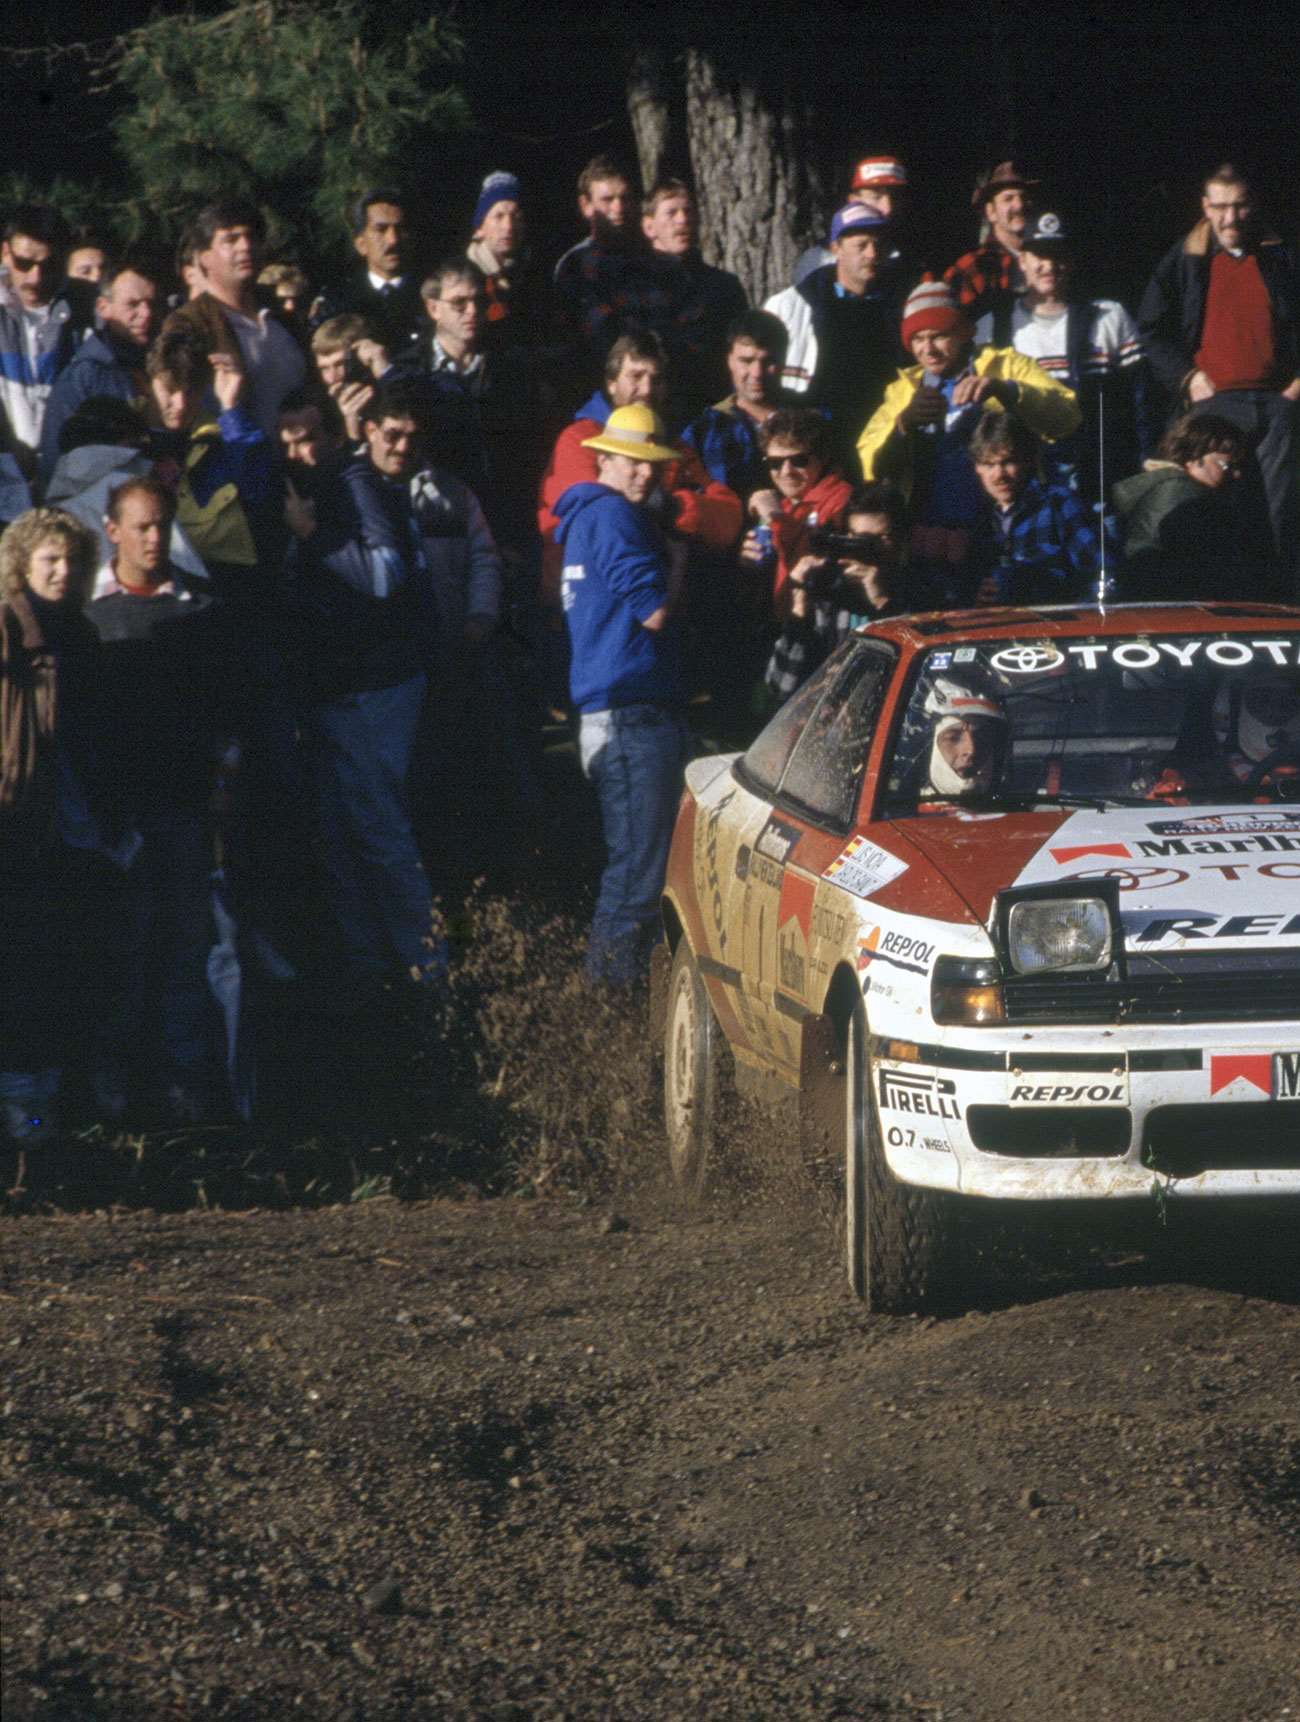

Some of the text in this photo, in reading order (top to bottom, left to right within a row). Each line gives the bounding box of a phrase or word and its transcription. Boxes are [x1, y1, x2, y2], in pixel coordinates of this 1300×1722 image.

[880, 931, 936, 963] REPSOL
[879, 1068, 962, 1120] PIRELLI
[1010, 1085, 1124, 1101] REPSOL
